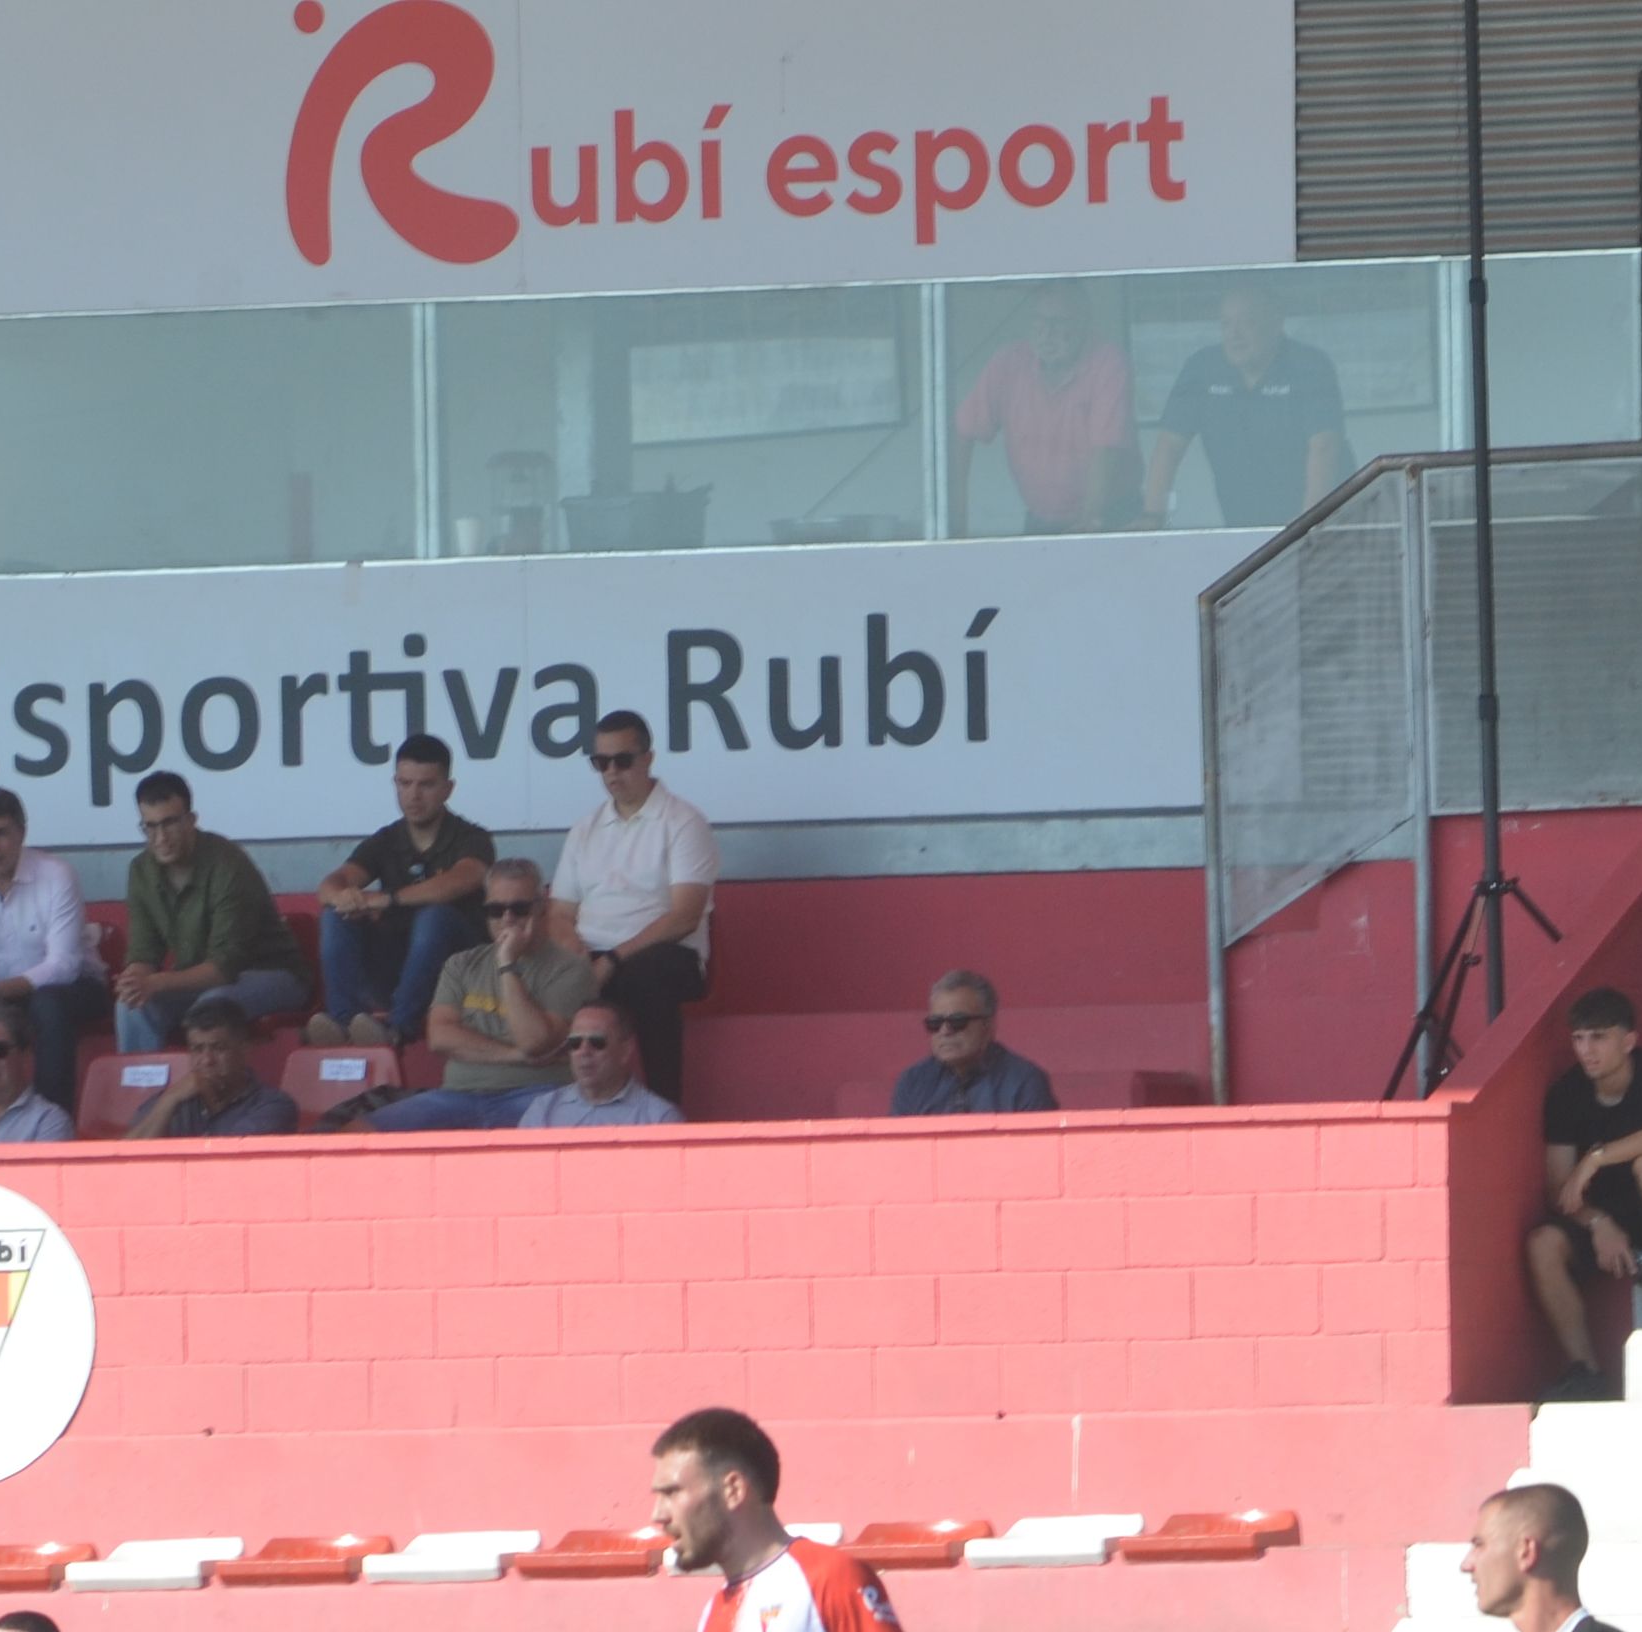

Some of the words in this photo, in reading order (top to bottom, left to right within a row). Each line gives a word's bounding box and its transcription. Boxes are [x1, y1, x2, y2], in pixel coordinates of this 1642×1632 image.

[286, 0, 729, 265] Rubí
[767, 97, 1186, 245] esport
[665, 608, 999, 754] Rubí
